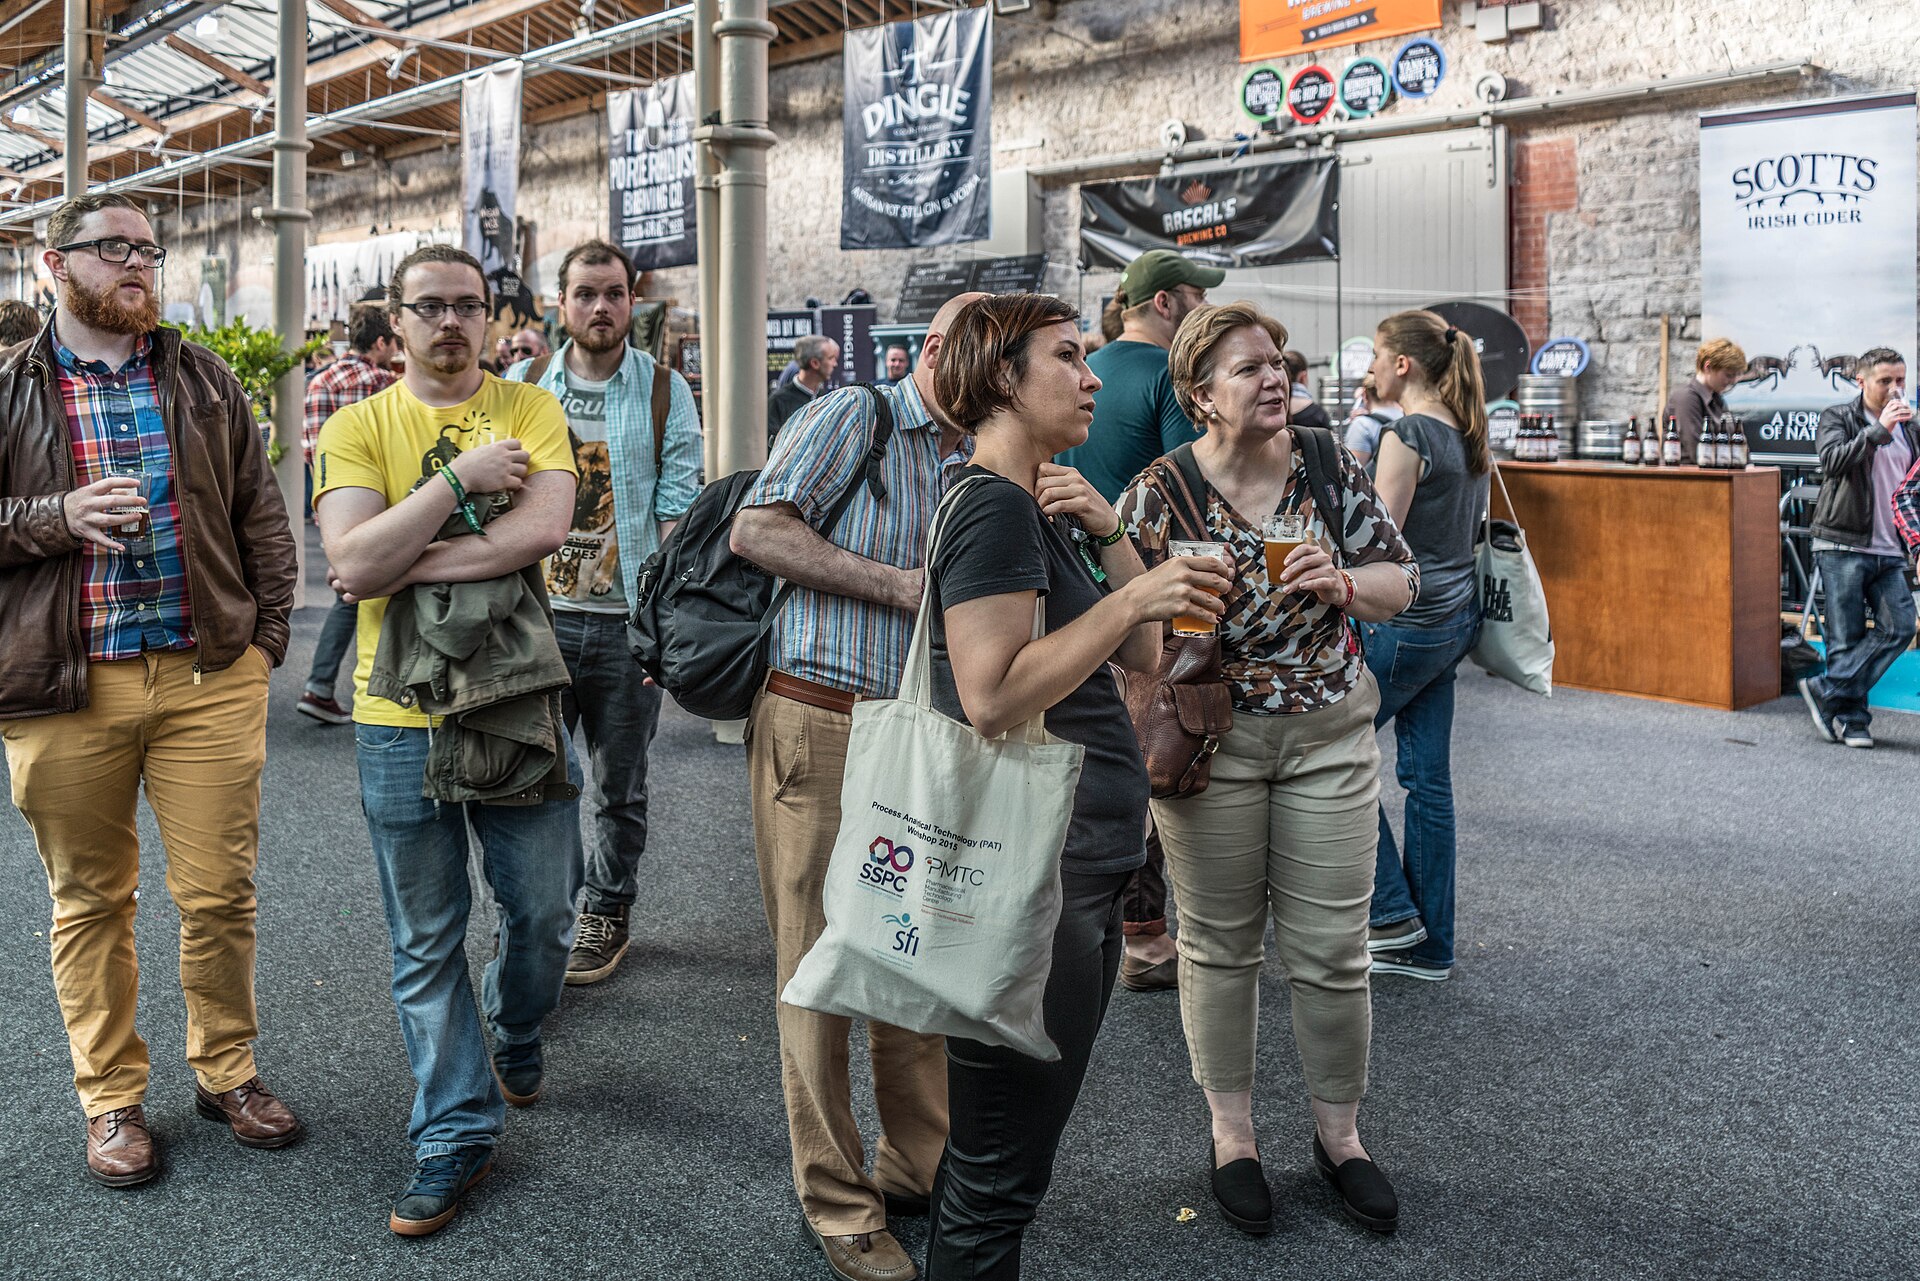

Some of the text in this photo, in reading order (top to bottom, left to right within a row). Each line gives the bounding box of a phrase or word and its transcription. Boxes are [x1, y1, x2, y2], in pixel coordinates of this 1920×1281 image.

[862, 83, 972, 139] DINGLE
[867, 138, 965, 167] DISTILLERY
[1731, 151, 1879, 202] SCOTTS
[622, 183, 668, 218] BREWING
[922, 198, 942, 216] GIN
[1162, 197, 1238, 235] RASCAL'S
[1747, 208, 1862, 231] IRISH CIDER
[1214, 223, 1228, 239] CO
[843, 313, 855, 370] DINGLE
[1760, 423, 1818, 442] OF NAT
[1770, 411, 1821, 428] A FOR
[561, 547, 598, 560] CHES
[1483, 591, 1511, 610] THE
[871, 801, 902, 819] Process
[933, 825, 978, 848] Technology
[979, 839, 1002, 852] (PAT)
[938, 838, 958, 852] 2015
[859, 862, 908, 893] SSPC
[892, 926, 920, 957] sfi
